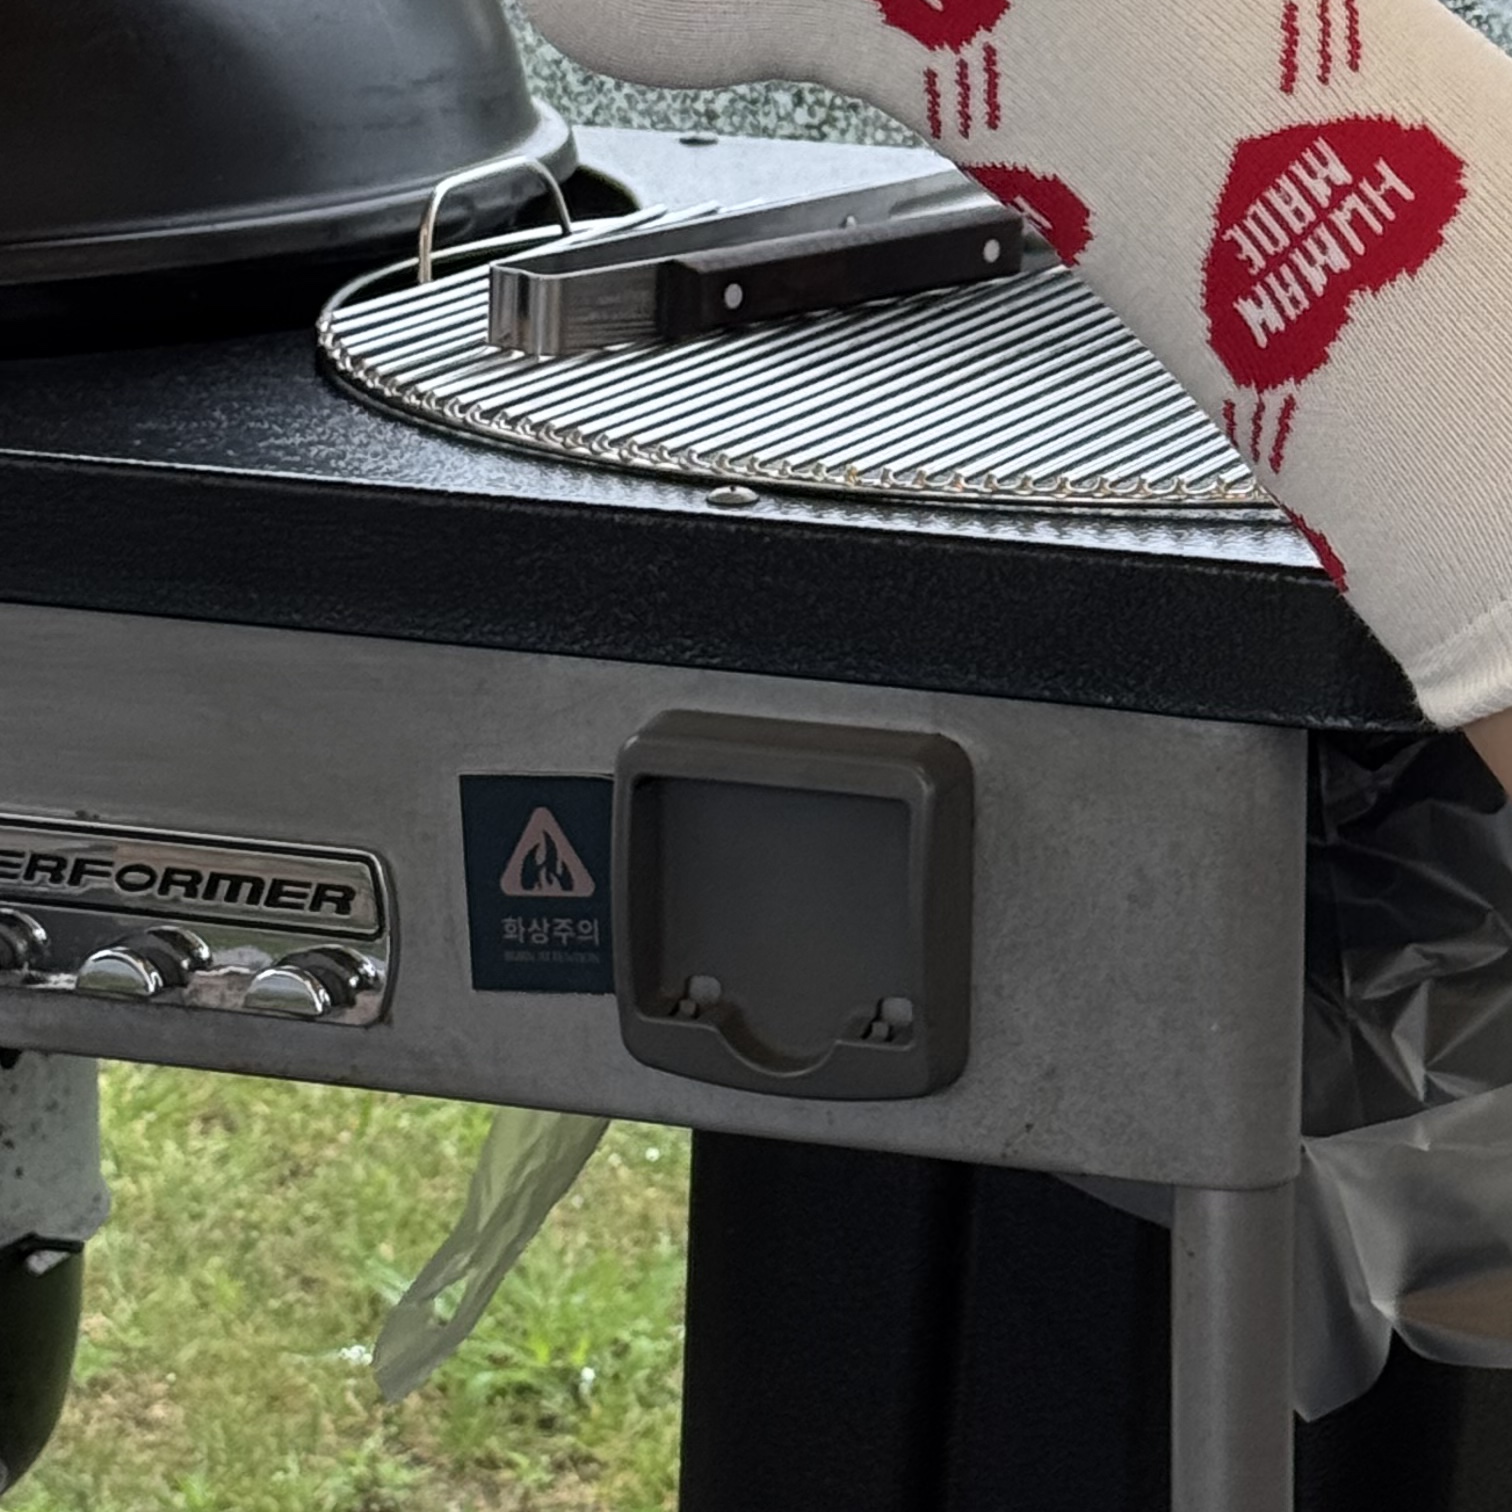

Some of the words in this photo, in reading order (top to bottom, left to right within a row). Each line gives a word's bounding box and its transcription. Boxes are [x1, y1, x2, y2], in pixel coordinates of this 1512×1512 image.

[1222, 136, 1353, 275] MADE
[1233, 156, 1416, 349] HUMAN
[0, 850, 358, 917] ERFORMER
[500, 915, 600, 946] 화상주의
